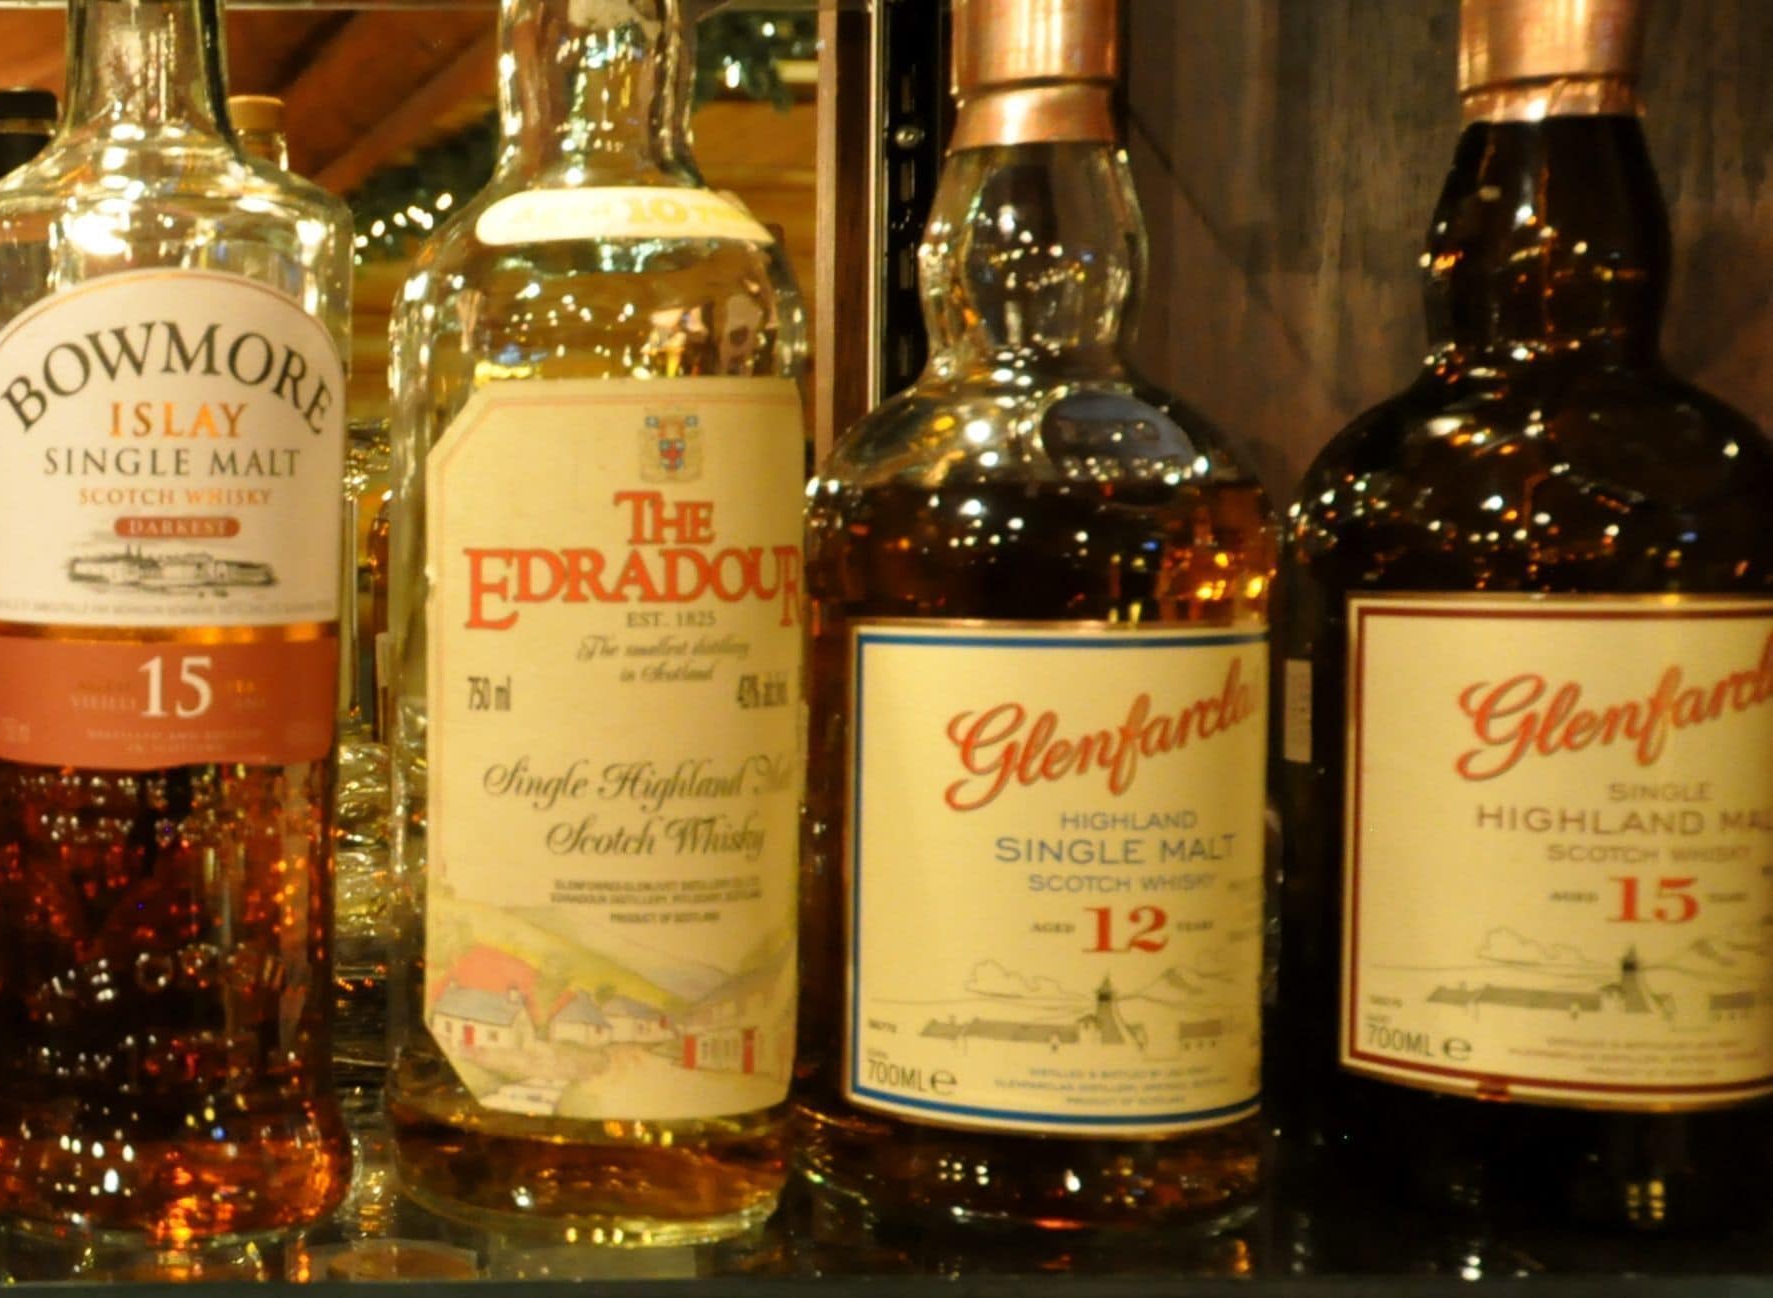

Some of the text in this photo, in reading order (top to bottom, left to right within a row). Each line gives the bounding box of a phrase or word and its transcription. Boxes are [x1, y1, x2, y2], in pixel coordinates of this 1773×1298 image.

[0, 320, 334, 436] BOWMORE
[109, 402, 248, 438] ISLAY
[43, 447, 302, 478] SINGLE MALT
[79, 488, 273, 506] SCOTCH WHISKY
[129, 519, 229, 536] DARKEST
[613, 490, 716, 546] THE
[462, 545, 803, 630] EDRADOUR
[675, 611, 716, 627] 1825
[576, 634, 621, 662] The
[138, 655, 214, 719] 15
[467, 675, 512, 711] 750 ml
[944, 656, 1257, 811] Glenfarcla
[483, 754, 589, 811] Single
[595, 755, 751, 812] Highland
[1608, 782, 1714, 802] SINGLE
[545, 809, 767, 862] Scotch Whisky
[1059, 810, 1199, 831] HIGHLAND
[1476, 805, 1706, 836] HIGHLAND
[994, 833, 1237, 865] SINGLE MALT
[1546, 844, 1659, 864] SCOTCH
[1028, 872, 1218, 893] SCOTCH WHISKY
[1605, 875, 1701, 925] 15
[1029, 921, 1075, 934] AGED
[1082, 905, 1170, 954] 12
[1367, 1022, 1435, 1059] 700ML
[867, 1058, 928, 1093] 700ML
